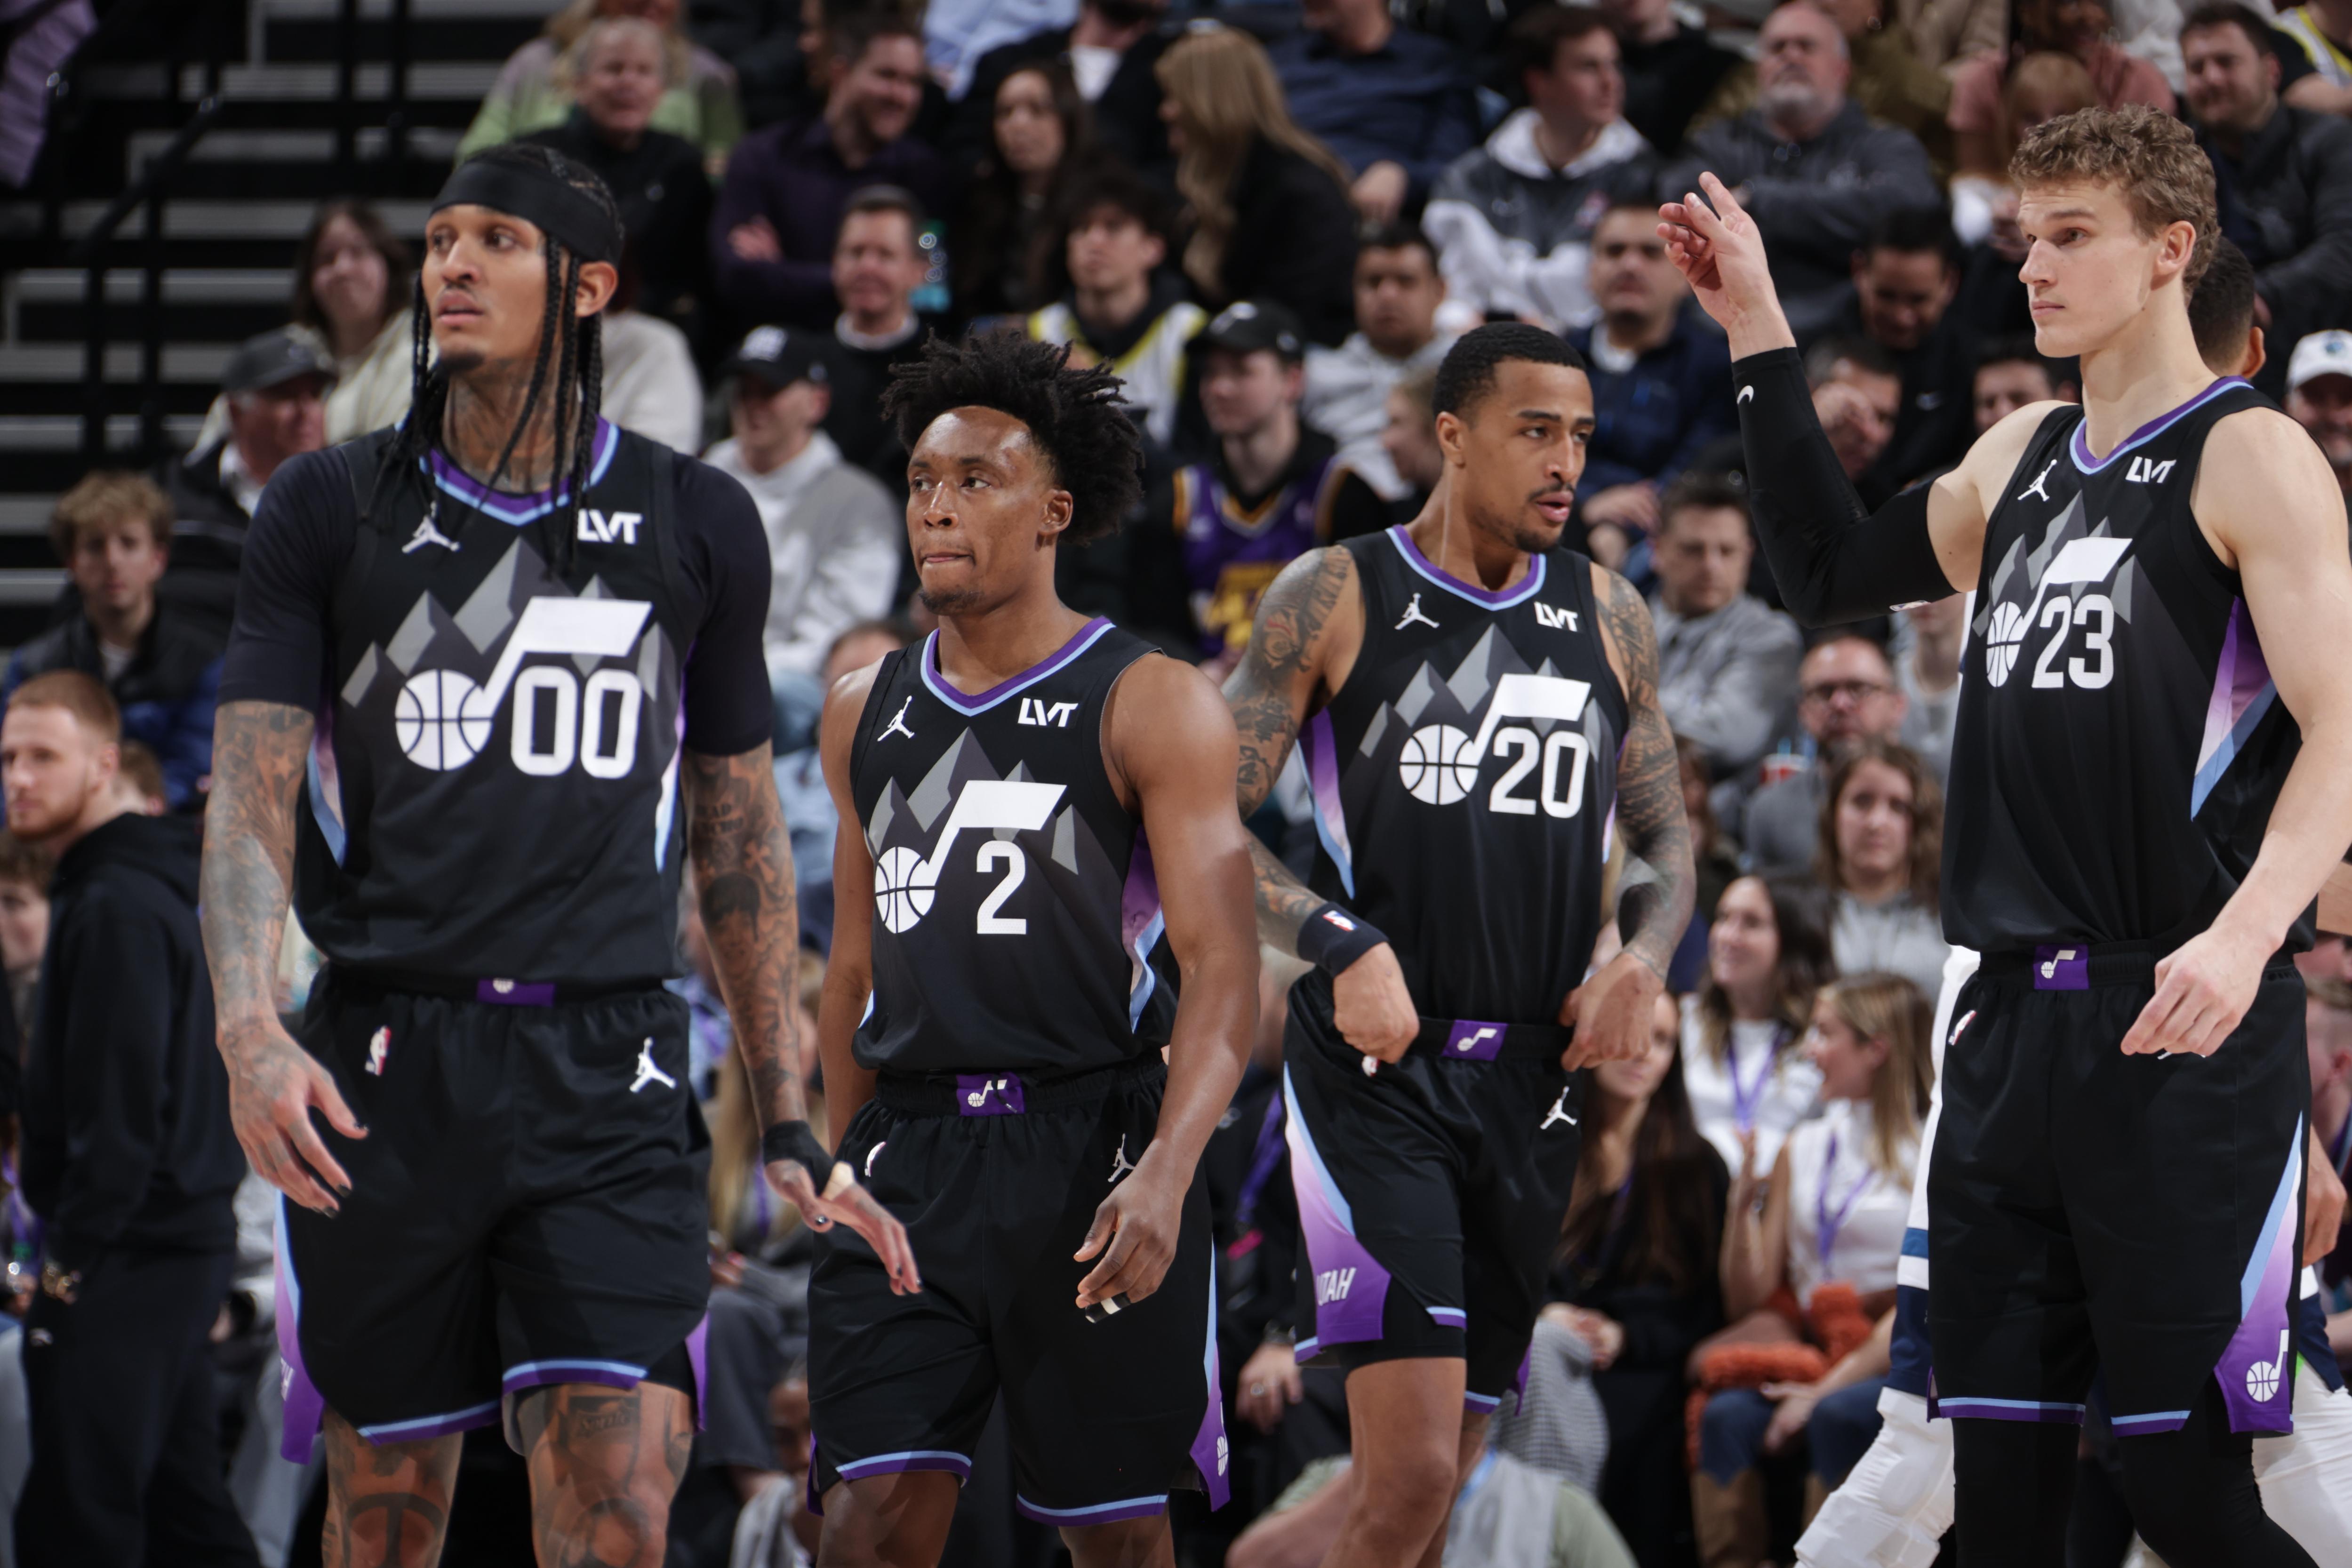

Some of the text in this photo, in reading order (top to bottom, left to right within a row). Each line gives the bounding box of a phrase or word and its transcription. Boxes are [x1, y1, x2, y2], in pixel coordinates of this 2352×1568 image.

[2126, 456, 2176, 483] LVT
[577, 510, 641, 544] LVT
[1534, 602, 1578, 632] LVT
[2032, 594, 2114, 688] 23
[511, 667, 642, 779] 00
[1017, 697, 1078, 728] LVT
[1489, 726, 1590, 819] 20
[976, 840, 1026, 935] 2
